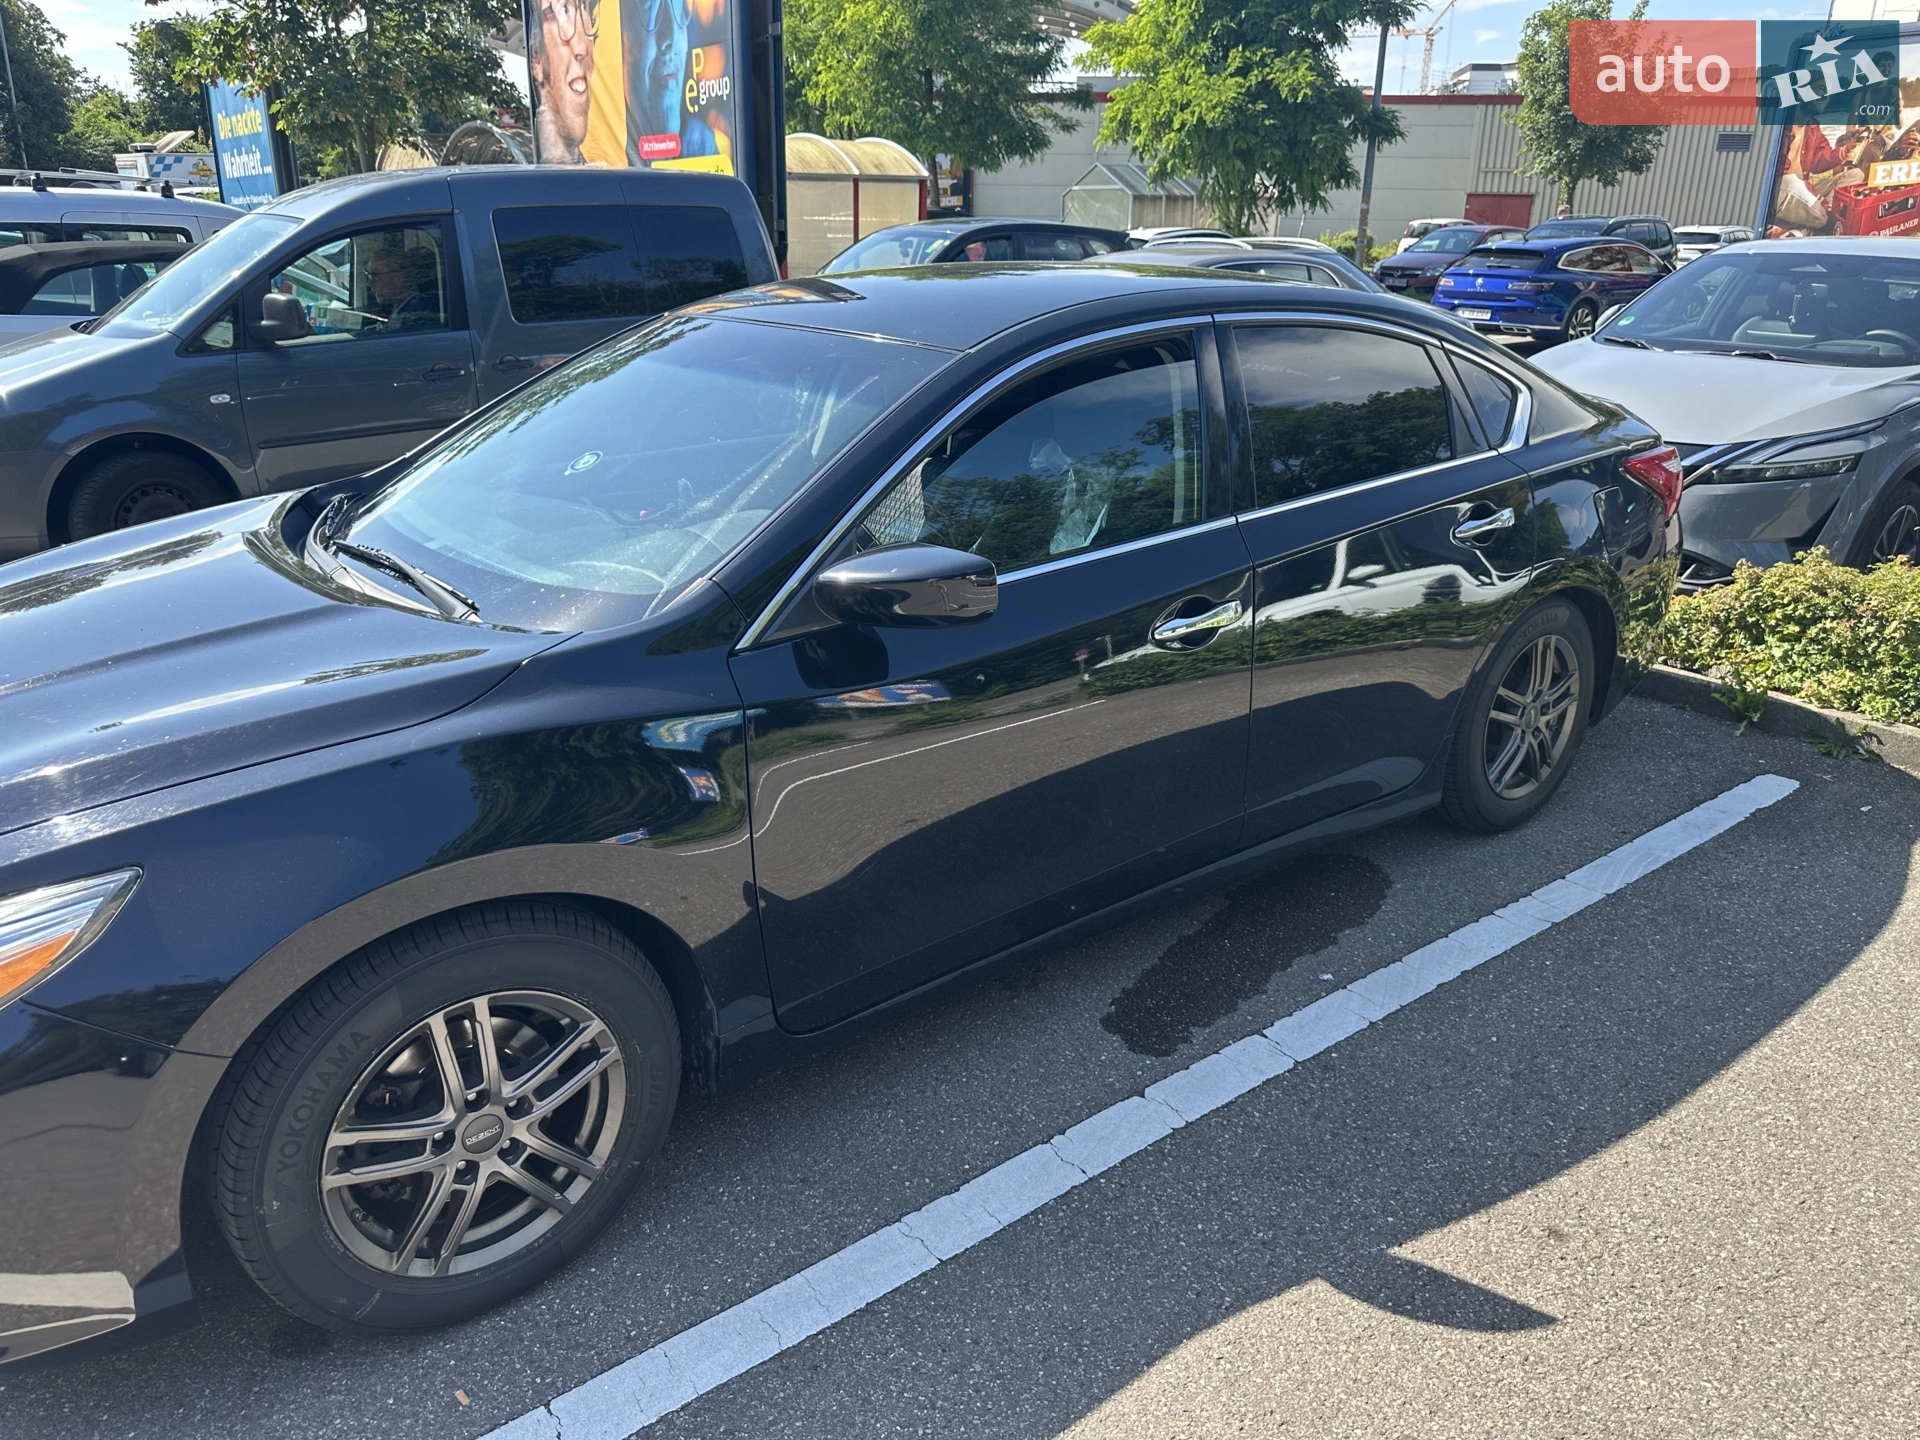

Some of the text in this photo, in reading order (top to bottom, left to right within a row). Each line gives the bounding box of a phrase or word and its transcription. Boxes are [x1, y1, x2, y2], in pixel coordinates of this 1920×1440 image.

[698, 76, 730, 105] group
[217, 104, 262, 140] Die nackte
[222, 144, 263, 179] Wahrheit
[1879, 218, 1919, 237] PAULANER
[276, 1031, 372, 1175] YOKOHAMA
[465, 1124, 501, 1146] DEZENT
